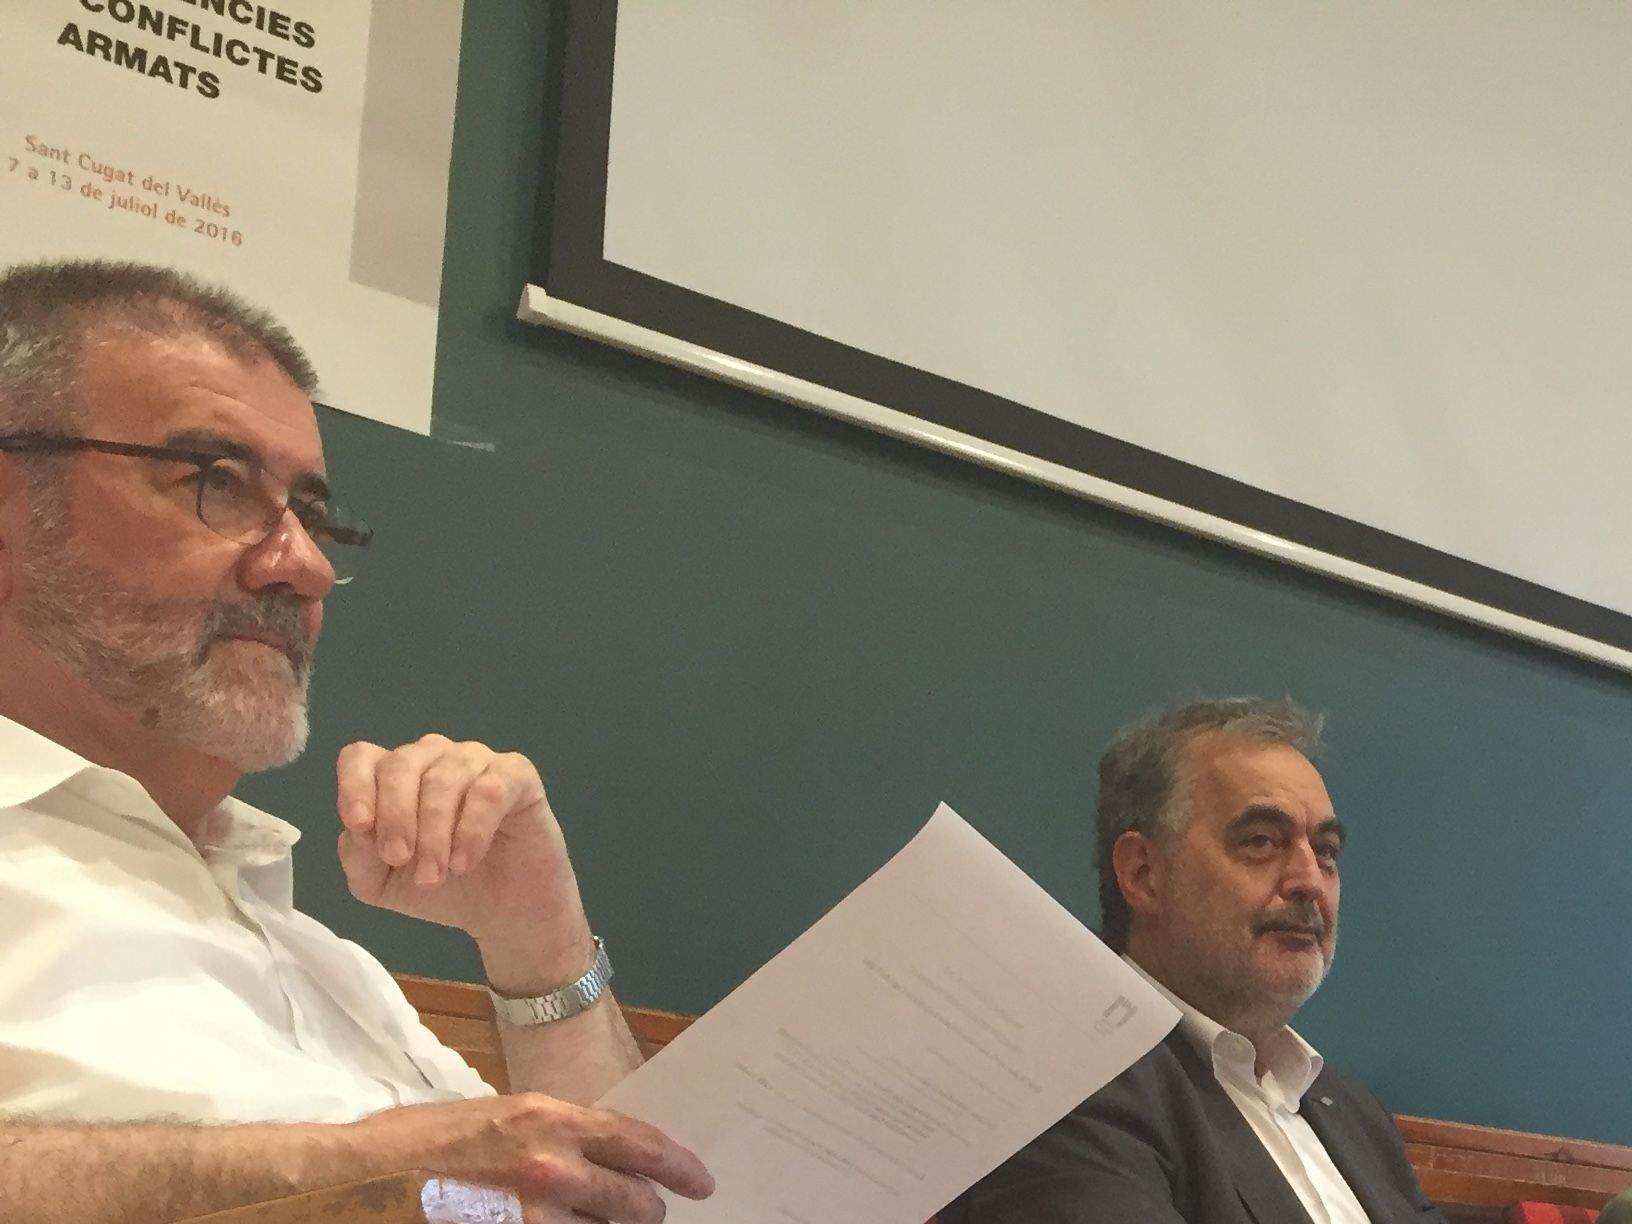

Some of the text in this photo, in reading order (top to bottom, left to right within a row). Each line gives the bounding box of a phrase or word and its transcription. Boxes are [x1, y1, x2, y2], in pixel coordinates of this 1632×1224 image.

[57, 22, 221, 99] ARMATS
[8, 156, 243, 247] 7 a 13 de juliol de 2016
[25, 134, 71, 165] Sant
[78, 152, 135, 186] Cugat
[142, 175, 170, 197] del
